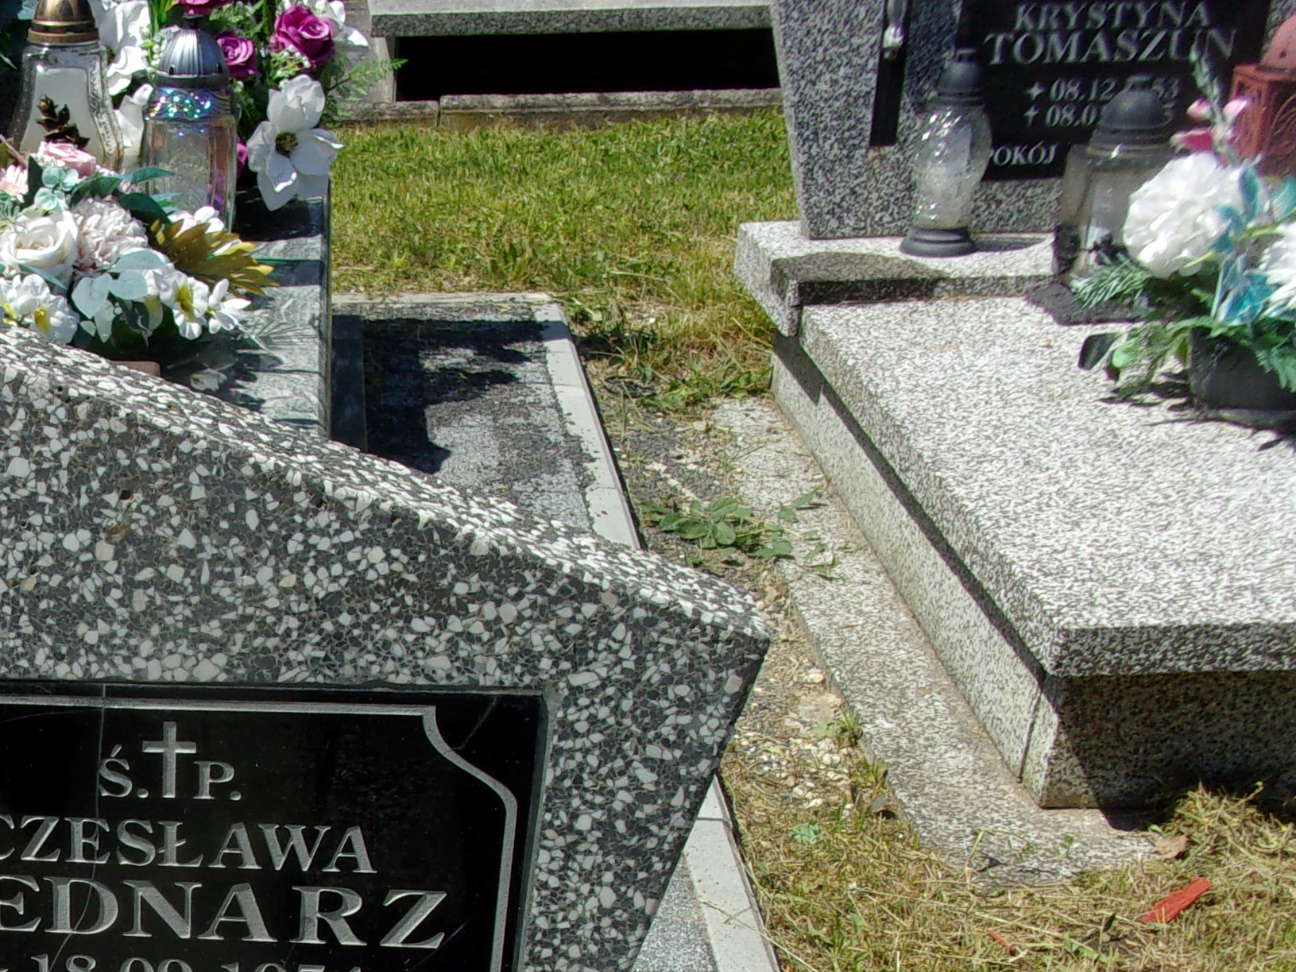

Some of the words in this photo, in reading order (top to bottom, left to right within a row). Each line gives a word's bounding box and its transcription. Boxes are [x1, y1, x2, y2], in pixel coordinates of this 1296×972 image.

[1013, 1, 1211, 31] KRYSTYNA
[99, 744, 149, 799] Ś.
[193, 760, 243, 801] P.
